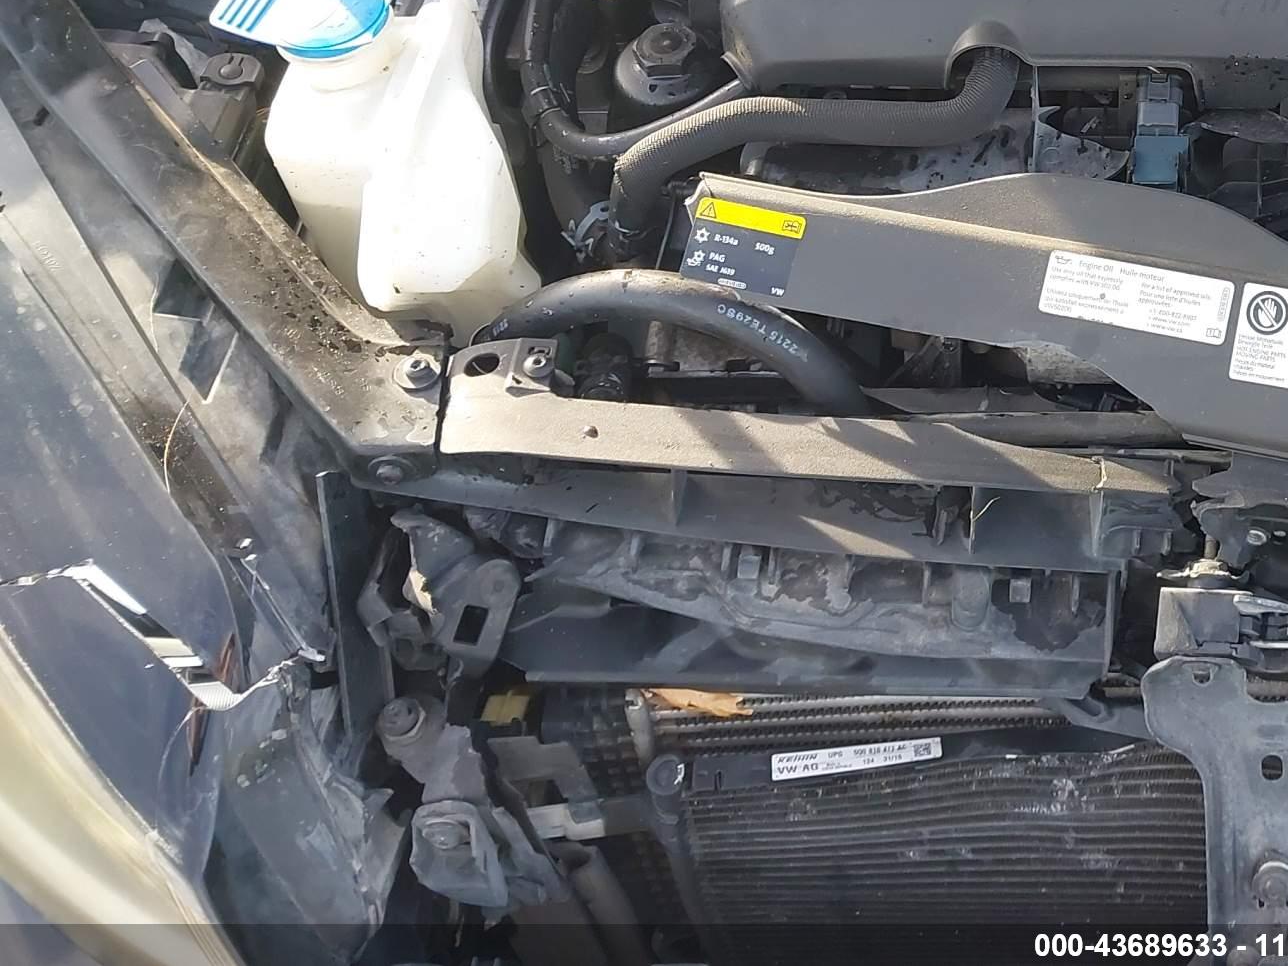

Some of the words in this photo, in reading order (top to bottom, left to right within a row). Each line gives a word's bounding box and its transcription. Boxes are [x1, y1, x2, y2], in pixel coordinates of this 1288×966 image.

[714, 234, 738, 245] R-134a
[709, 252, 725, 262] PAG
[706, 264, 718, 272] SAE
[1078, 260, 1101, 272] Engine
[1119, 267, 1137, 276] Huile
[1139, 271, 1164, 281] moteur
[770, 287, 784, 295] VW
[777, 764, 798, 775] VW
[802, 763, 819, 772] AG
